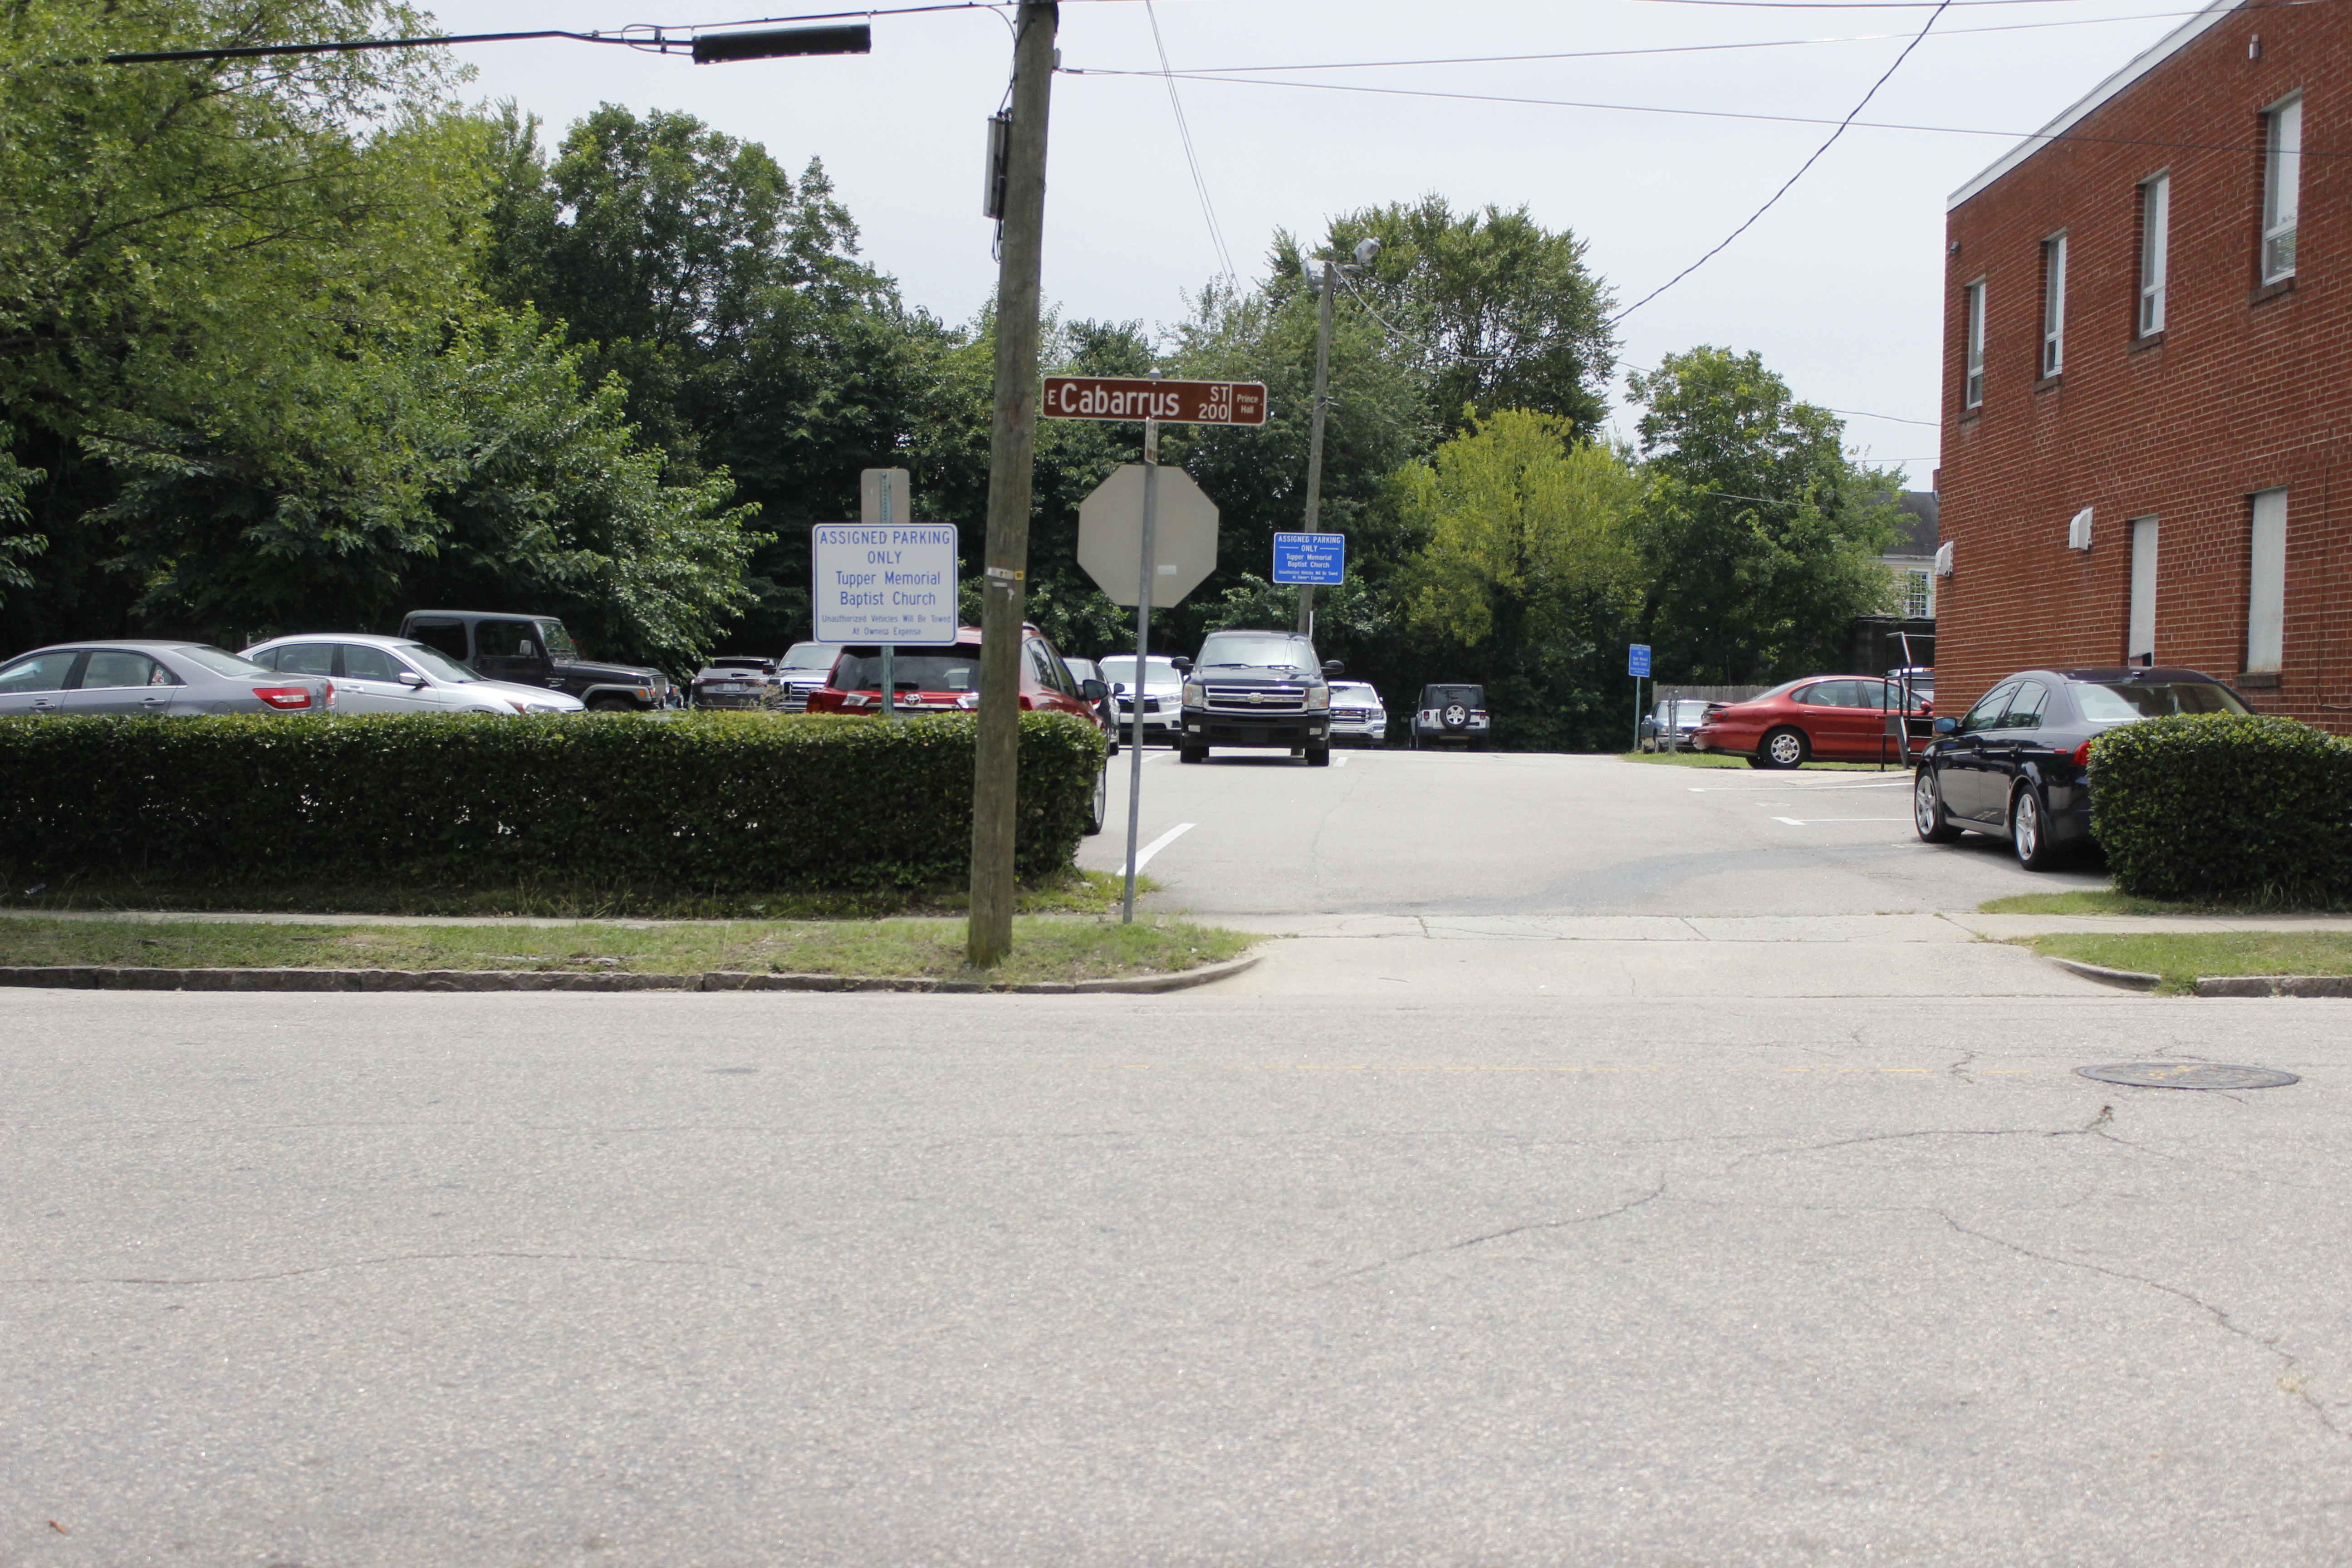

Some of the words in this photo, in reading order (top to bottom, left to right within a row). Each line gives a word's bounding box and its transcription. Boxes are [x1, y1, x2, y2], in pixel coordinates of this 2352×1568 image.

[1048, 390, 1057, 405] E
[1060, 383, 1180, 416] Cabarrus
[1210, 386, 1229, 402] ST
[1236, 394, 1259, 403] Prince
[1198, 403, 1228, 420] 200
[1240, 405, 1254, 414] Hall
[820, 531, 887, 544] ASSIGNED
[893, 531, 950, 544] PARKING
[867, 551, 902, 564] ONLY
[836, 571, 876, 588] Tupper
[885, 571, 941, 585] Memorial
[840, 591, 884, 608] Baptist
[892, 591, 936, 605] Church
[893, 627, 921, 637] Expense
